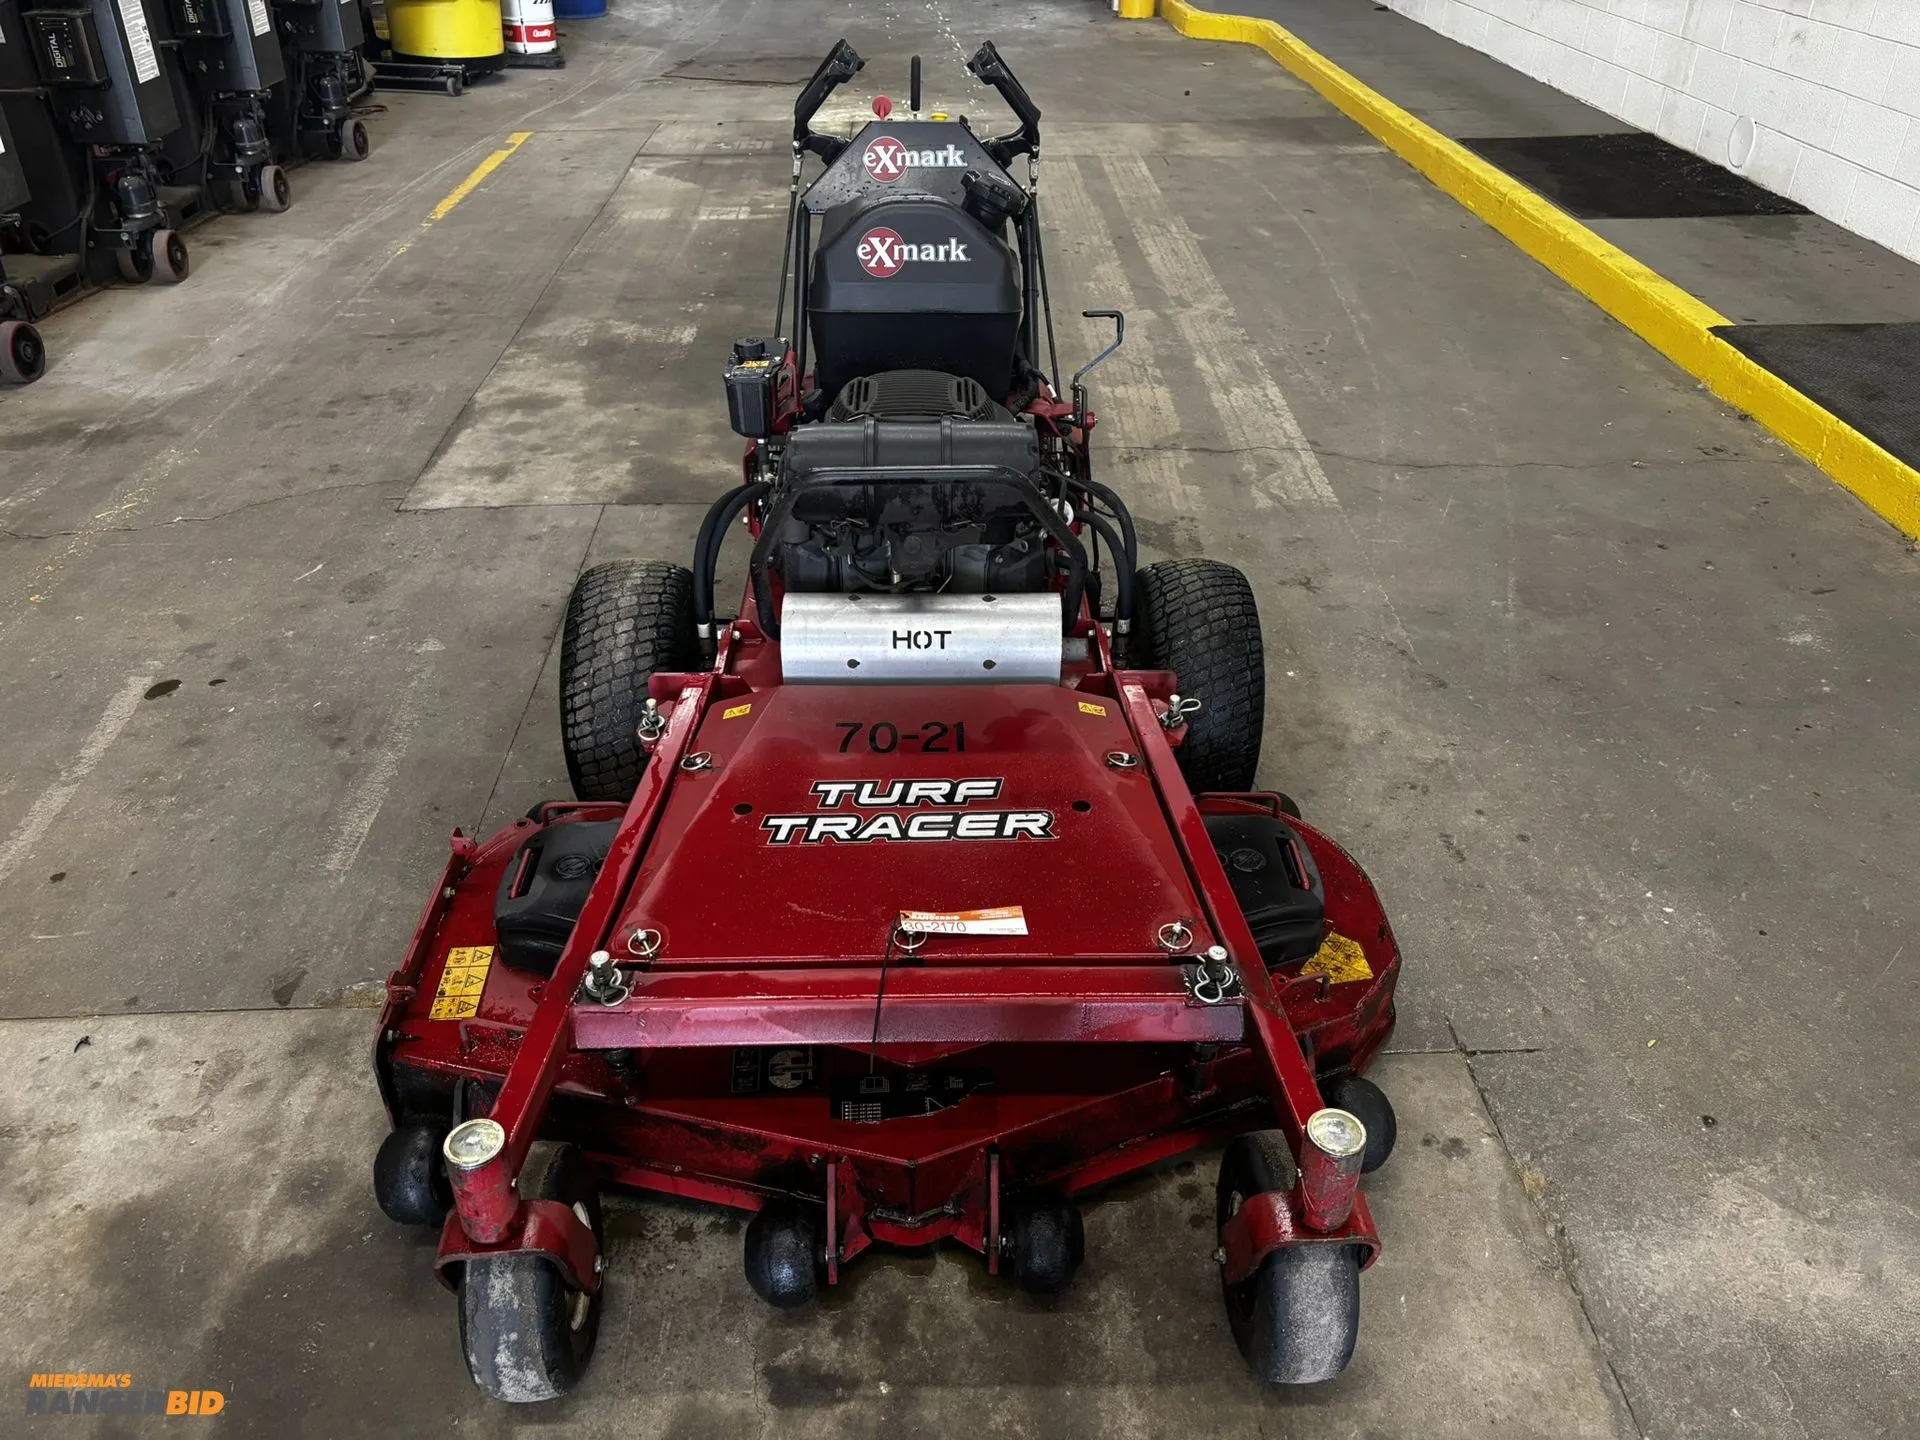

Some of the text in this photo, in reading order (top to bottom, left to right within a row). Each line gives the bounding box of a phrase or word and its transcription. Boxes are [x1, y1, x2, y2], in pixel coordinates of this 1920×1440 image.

[48, 32, 64, 68] DIGITAL
[892, 630, 952, 650] HOT
[835, 721, 966, 753] 70-21
[811, 779, 1001, 808] TURF
[763, 812, 1057, 843] TRACER
[904, 921, 967, 932] 30-2170
